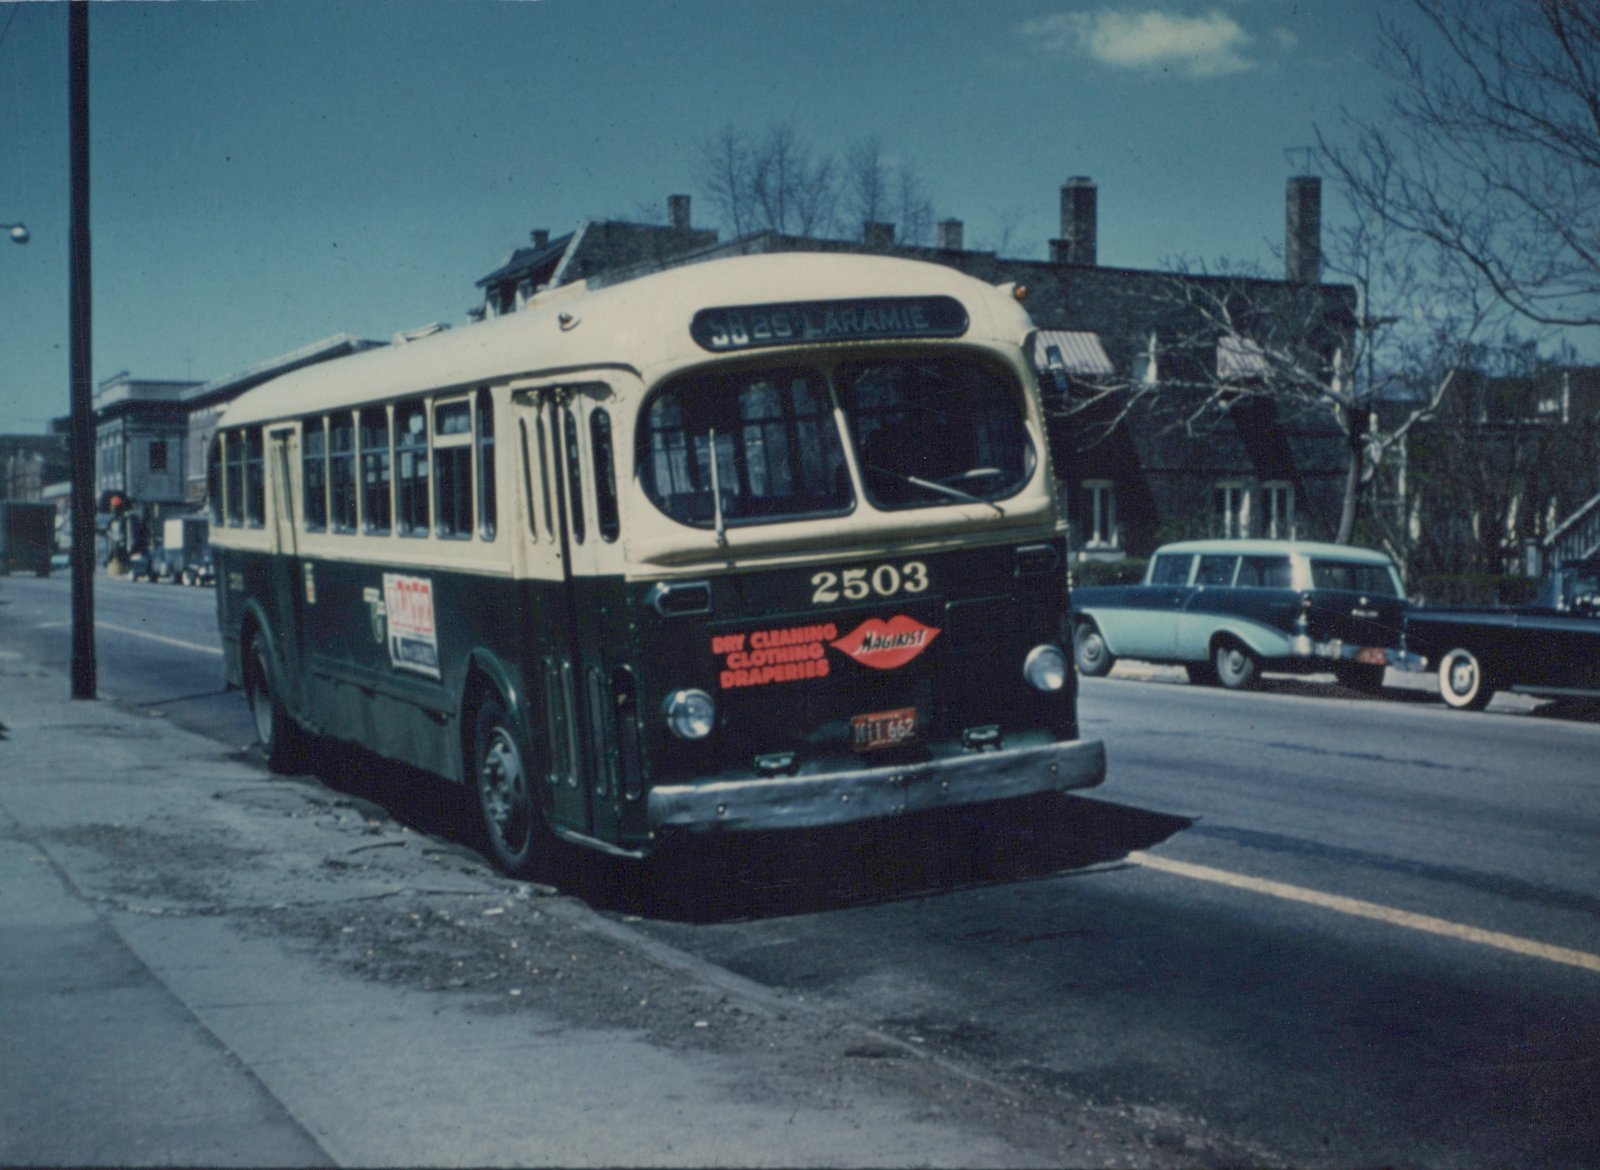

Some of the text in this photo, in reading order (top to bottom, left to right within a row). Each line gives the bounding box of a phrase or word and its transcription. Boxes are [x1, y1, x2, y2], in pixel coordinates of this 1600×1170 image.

[801, 305, 929, 337] LARAMIE
[811, 561, 929, 603] 2503
[711, 622, 838, 654] DRY CLEANING
[859, 629, 927, 653] MAGIKIST
[726, 642, 825, 669] CLOTHING
[719, 658, 831, 689] DRAPERIES
